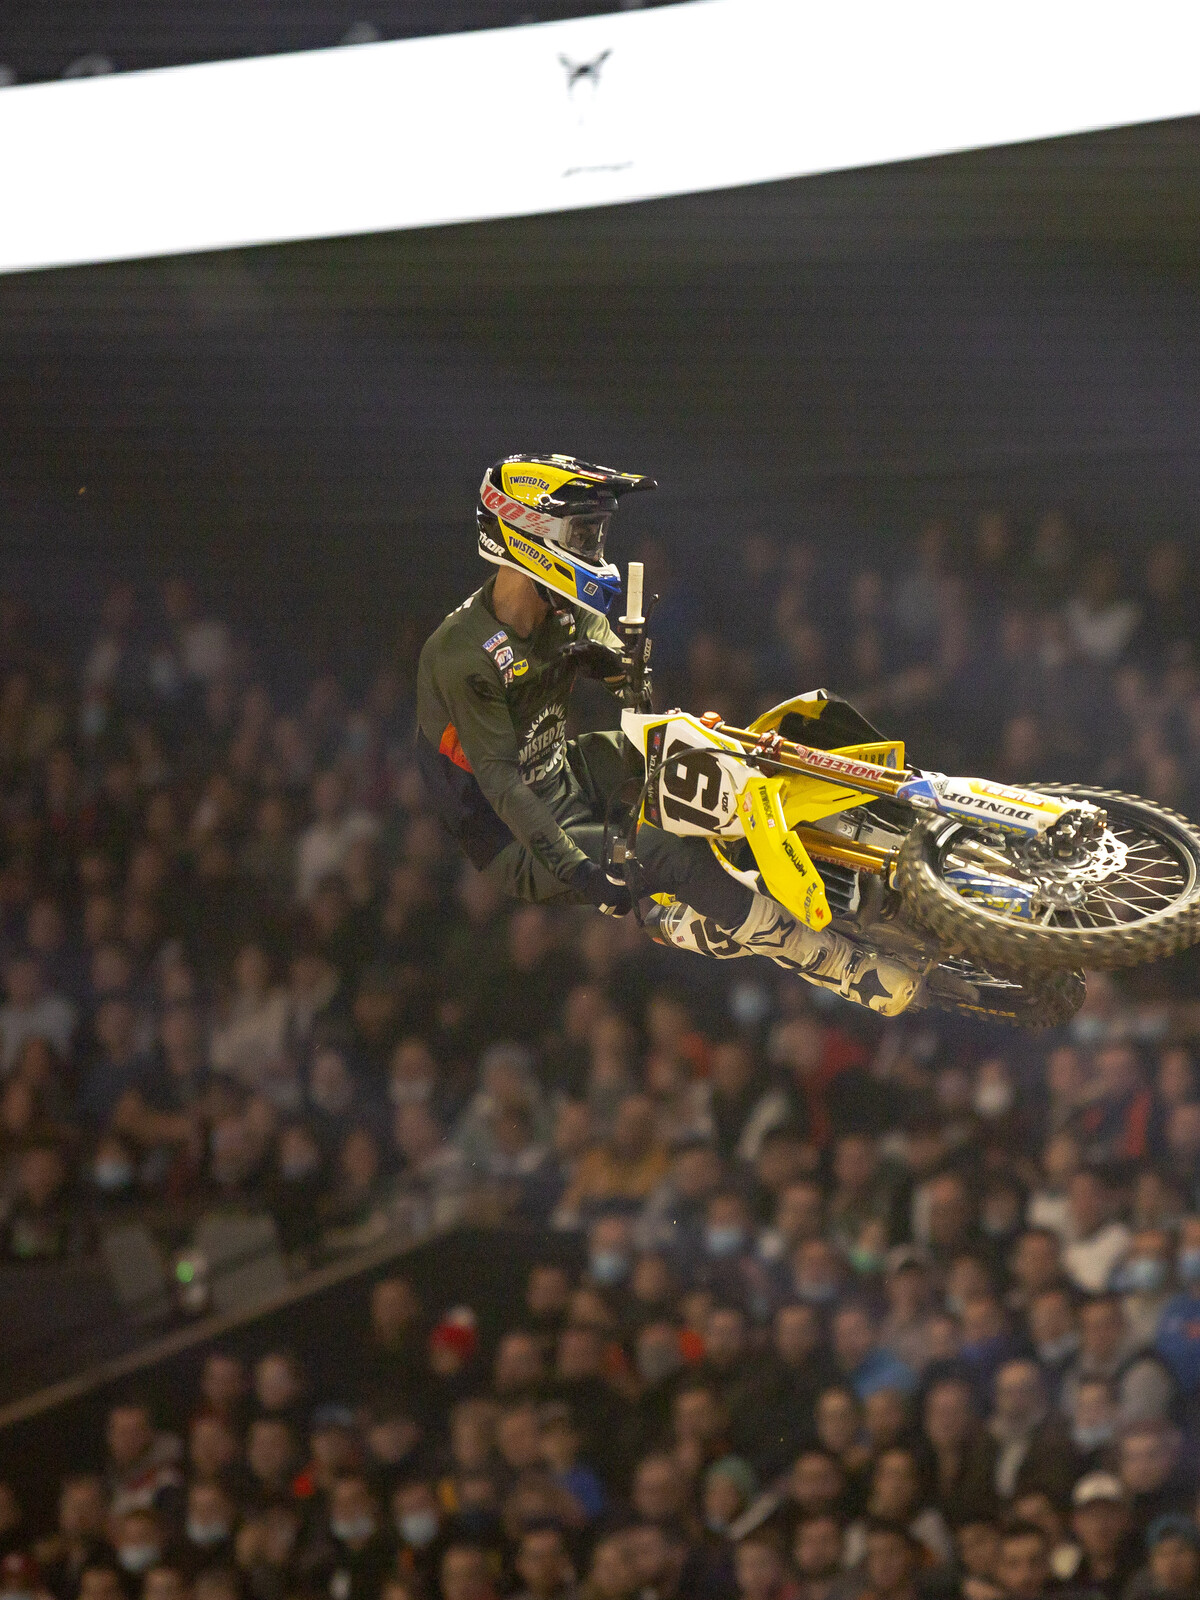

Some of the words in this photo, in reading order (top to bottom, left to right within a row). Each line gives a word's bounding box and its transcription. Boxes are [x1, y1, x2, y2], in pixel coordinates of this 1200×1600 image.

[509, 475, 537, 486] TWISTED
[537, 478, 550, 491] TEA
[481, 484, 555, 536] 100%
[480, 531, 506, 557] THOR
[508, 536, 540, 560] TWISTED
[538, 553, 553, 572] TEA
[519, 726, 556, 766] WISTED
[521, 744, 563, 785] UZUK
[807, 753, 883, 782] NOLEEN
[663, 738, 723, 835] 19
[942, 793, 1034, 820] DUNLOP
[781, 839, 808, 878] MAYHEM
[806, 882, 819, 898] TEA
